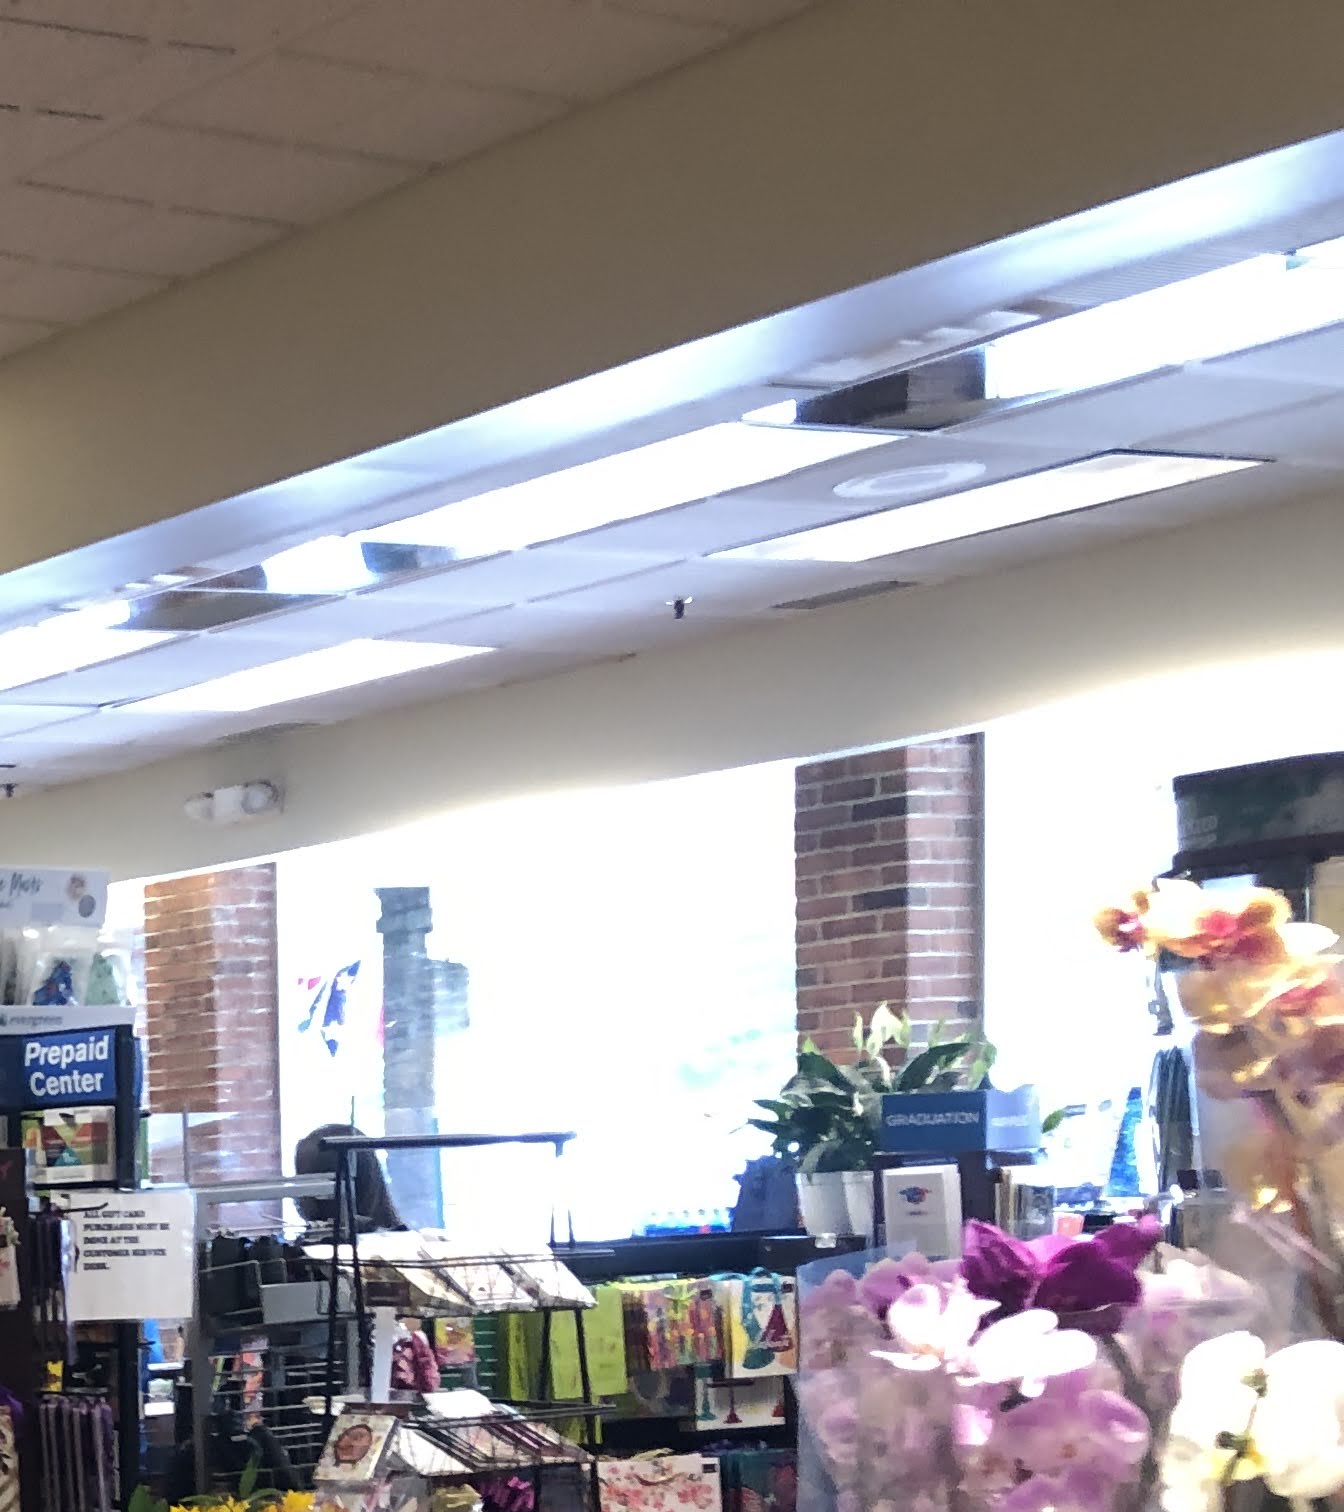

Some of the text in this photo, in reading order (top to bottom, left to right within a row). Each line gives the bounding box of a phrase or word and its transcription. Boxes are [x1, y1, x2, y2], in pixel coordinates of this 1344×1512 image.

[24, 1034, 110, 1070] Prepaid
[30, 1072, 104, 1097] Center
[885, 1111, 980, 1127] GRADUATION
